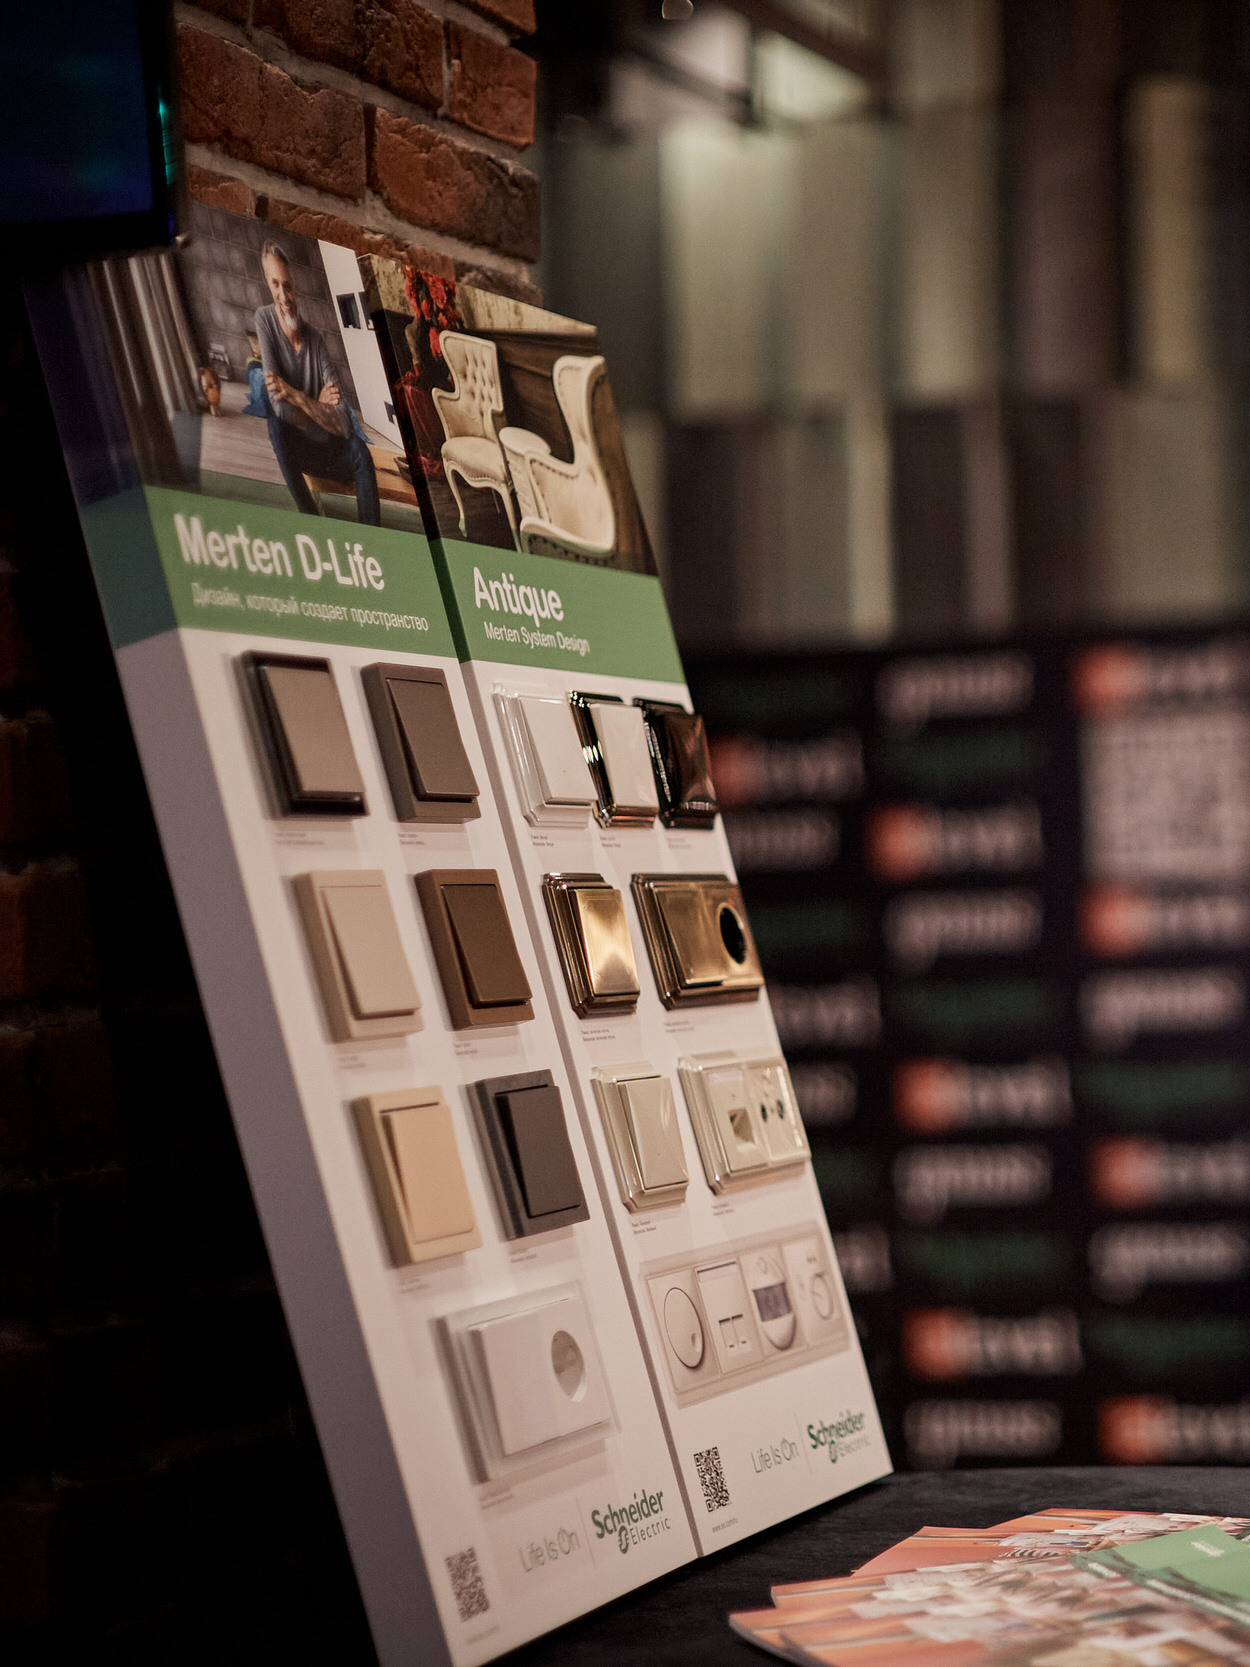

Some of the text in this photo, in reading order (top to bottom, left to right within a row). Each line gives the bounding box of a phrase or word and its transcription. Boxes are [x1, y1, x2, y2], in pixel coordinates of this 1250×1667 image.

[173, 513, 386, 591] Merten D-Life
[190, 582, 429, 632] Дизайн, который создает пространство
[473, 566, 564, 628] Antique
[483, 621, 590, 657] Merten System Design
[806, 1409, 864, 1450] Schneider
[751, 1448, 773, 1473] Life
[770, 1444, 782, 1466] Is
[591, 1489, 664, 1539] Schneider
[629, 1516, 671, 1546] Electric
